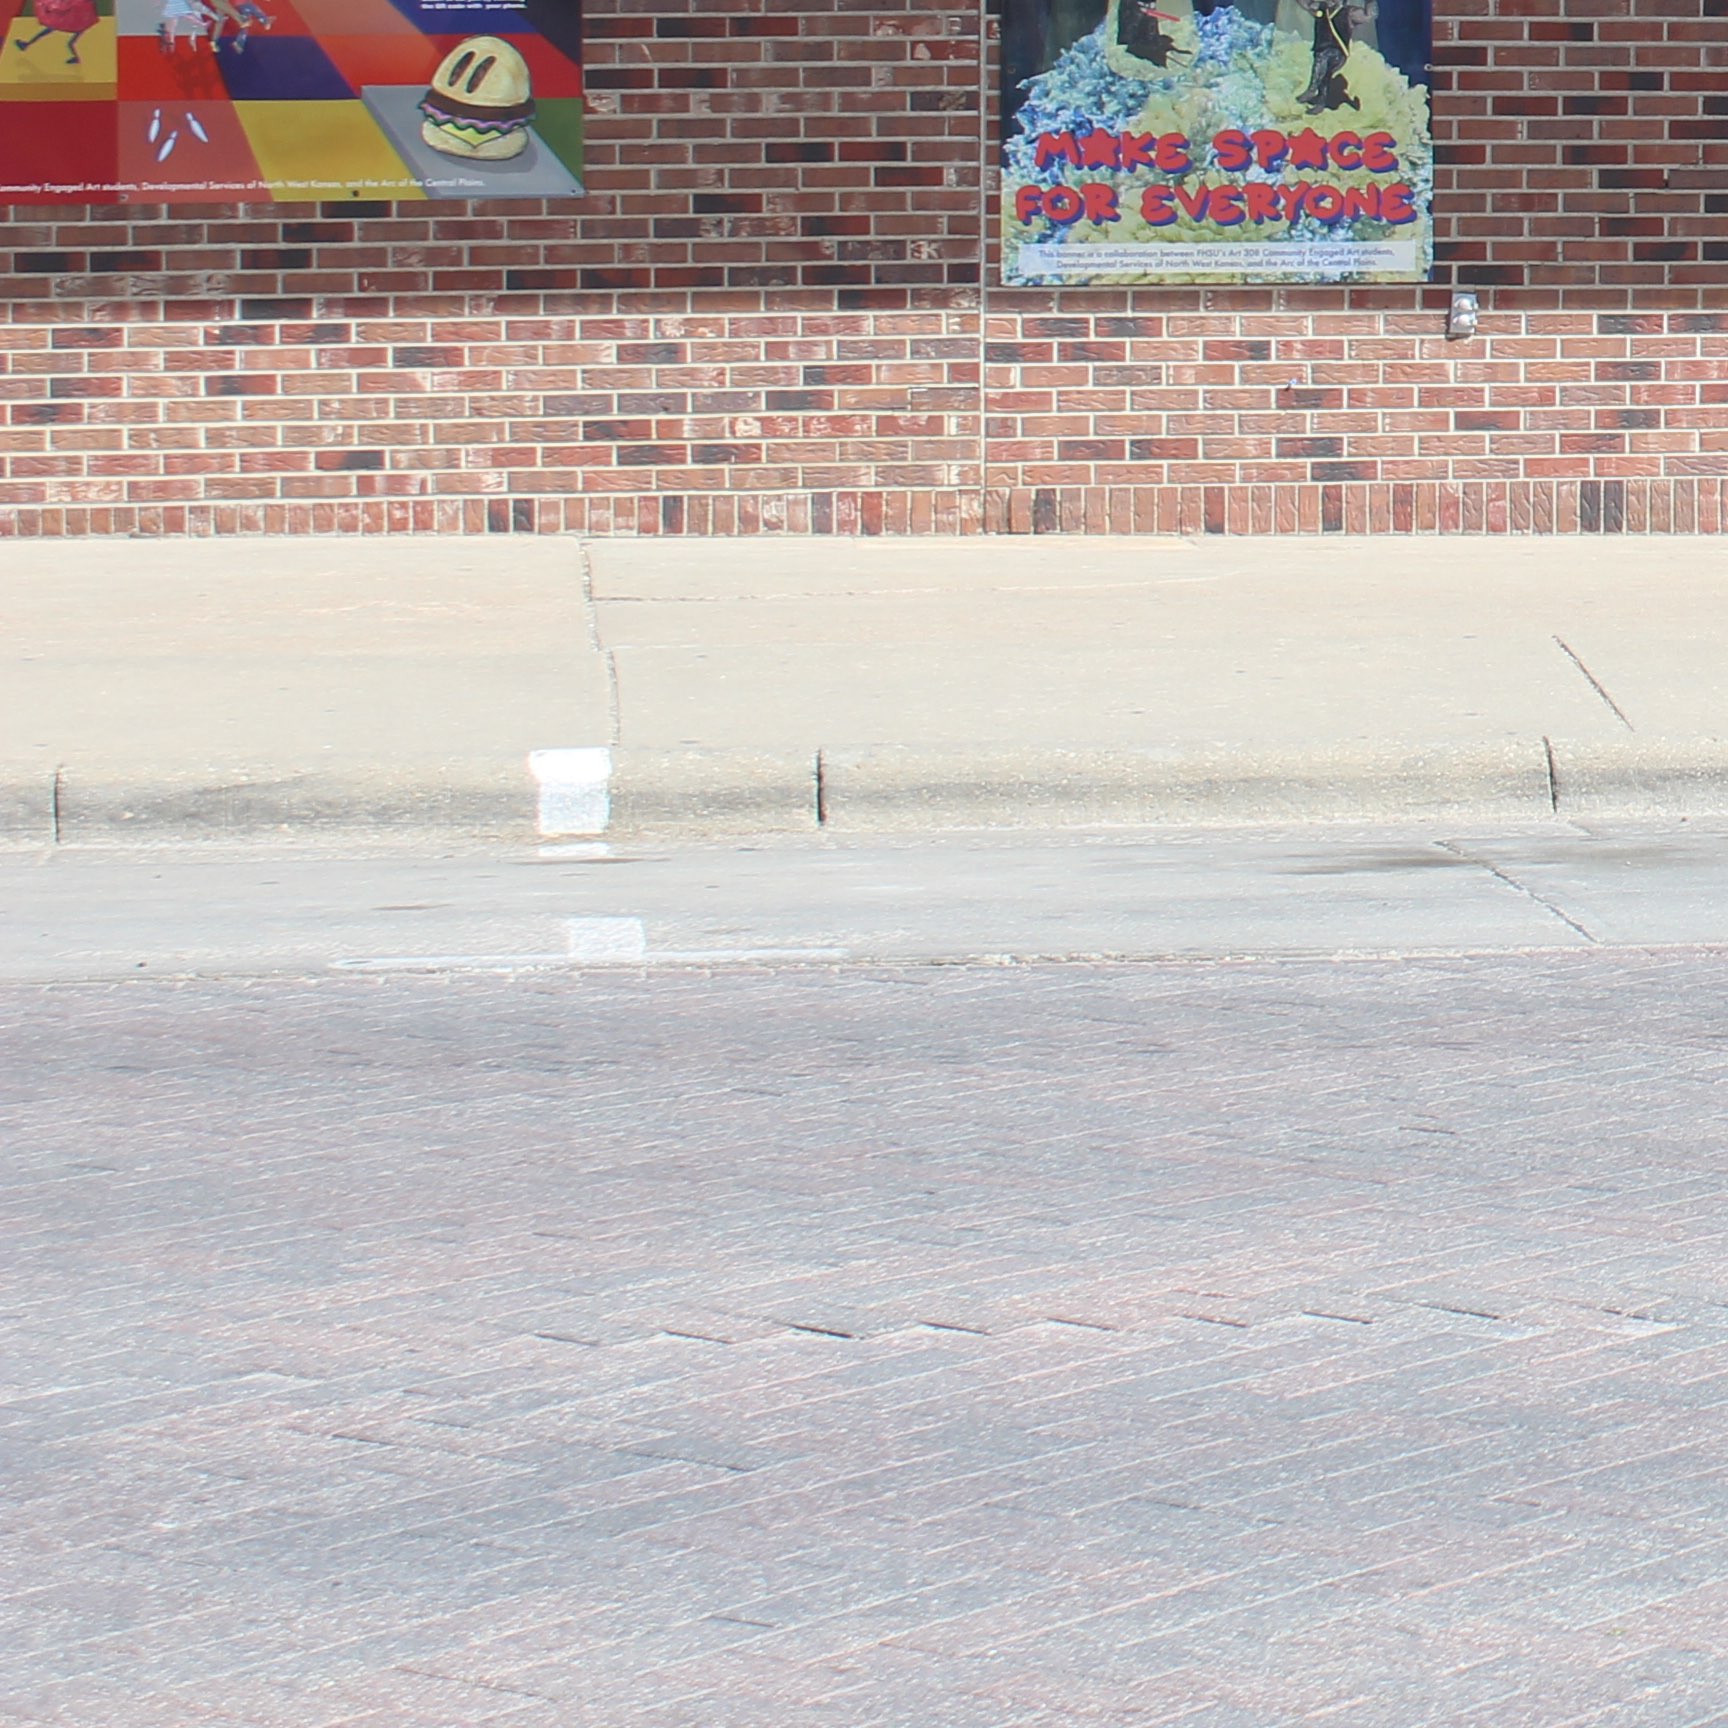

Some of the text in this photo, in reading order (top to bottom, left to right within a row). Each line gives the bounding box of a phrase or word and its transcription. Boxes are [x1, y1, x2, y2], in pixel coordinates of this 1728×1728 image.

[0, 183, 42, 193] ommunity
[44, 183, 84, 193] Engaged
[86, 183, 101, 191] Art
[142, 181, 207, 192] Developmental
[209, 181, 245, 190] Services
[425, 179, 457, 187] Central
[1015, 181, 1418, 225] FOR EVERYONE
[1103, 250, 1159, 258] collaboration
[1160, 250, 1195, 258] between
[1228, 249, 1242, 257] Art
[1262, 249, 1306, 258] Community
[1309, 248, 1345, 258] Engaged
[1347, 248, 1361, 256] Art
[1056, 260, 1118, 270] Developmental
[1119, 260, 1152, 268] Services
[1155, 260, 1163, 268] of
[1166, 260, 1190, 268] North
[1192, 259, 1213, 268] West
[1265, 259, 1278, 267] the
[1281, 259, 1295, 267] Arc
[1307, 258, 1320, 267] the
[1322, 258, 1351, 267] Central
